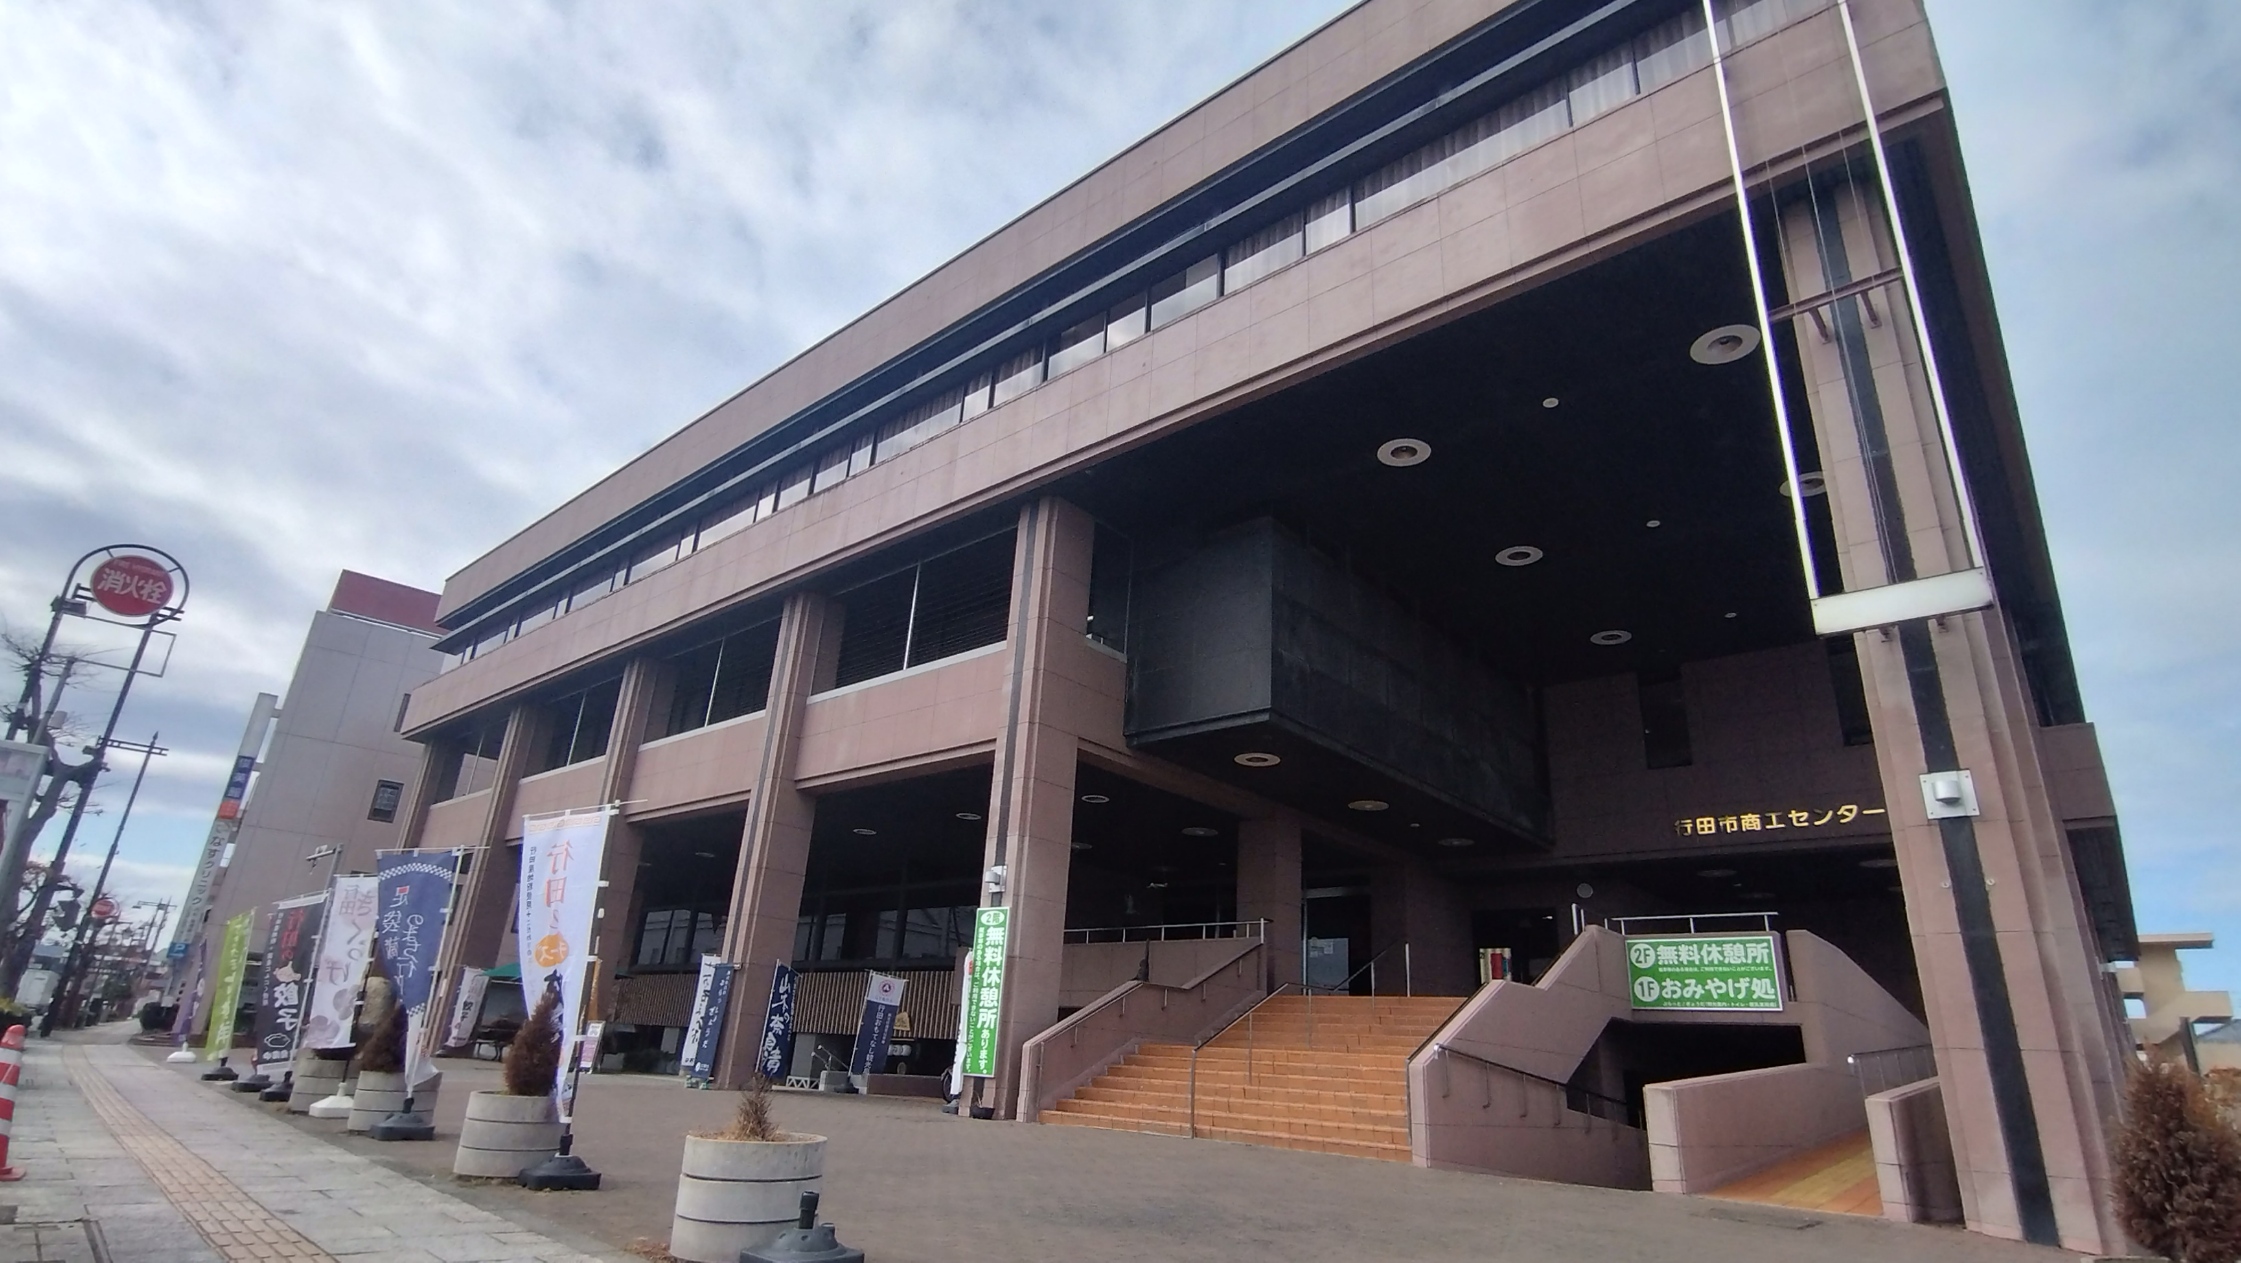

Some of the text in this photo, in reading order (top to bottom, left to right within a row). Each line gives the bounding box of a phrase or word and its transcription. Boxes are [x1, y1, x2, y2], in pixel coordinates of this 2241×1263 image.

[97, 568, 167, 604] 消火栓
[1674, 804, 1886, 837] 行田市商工センター
[986, 913, 1001, 924] 2階
[1634, 942, 1769, 965] 2F 無料休憩所
[1638, 976, 1776, 1000] 1F おみやげ処
